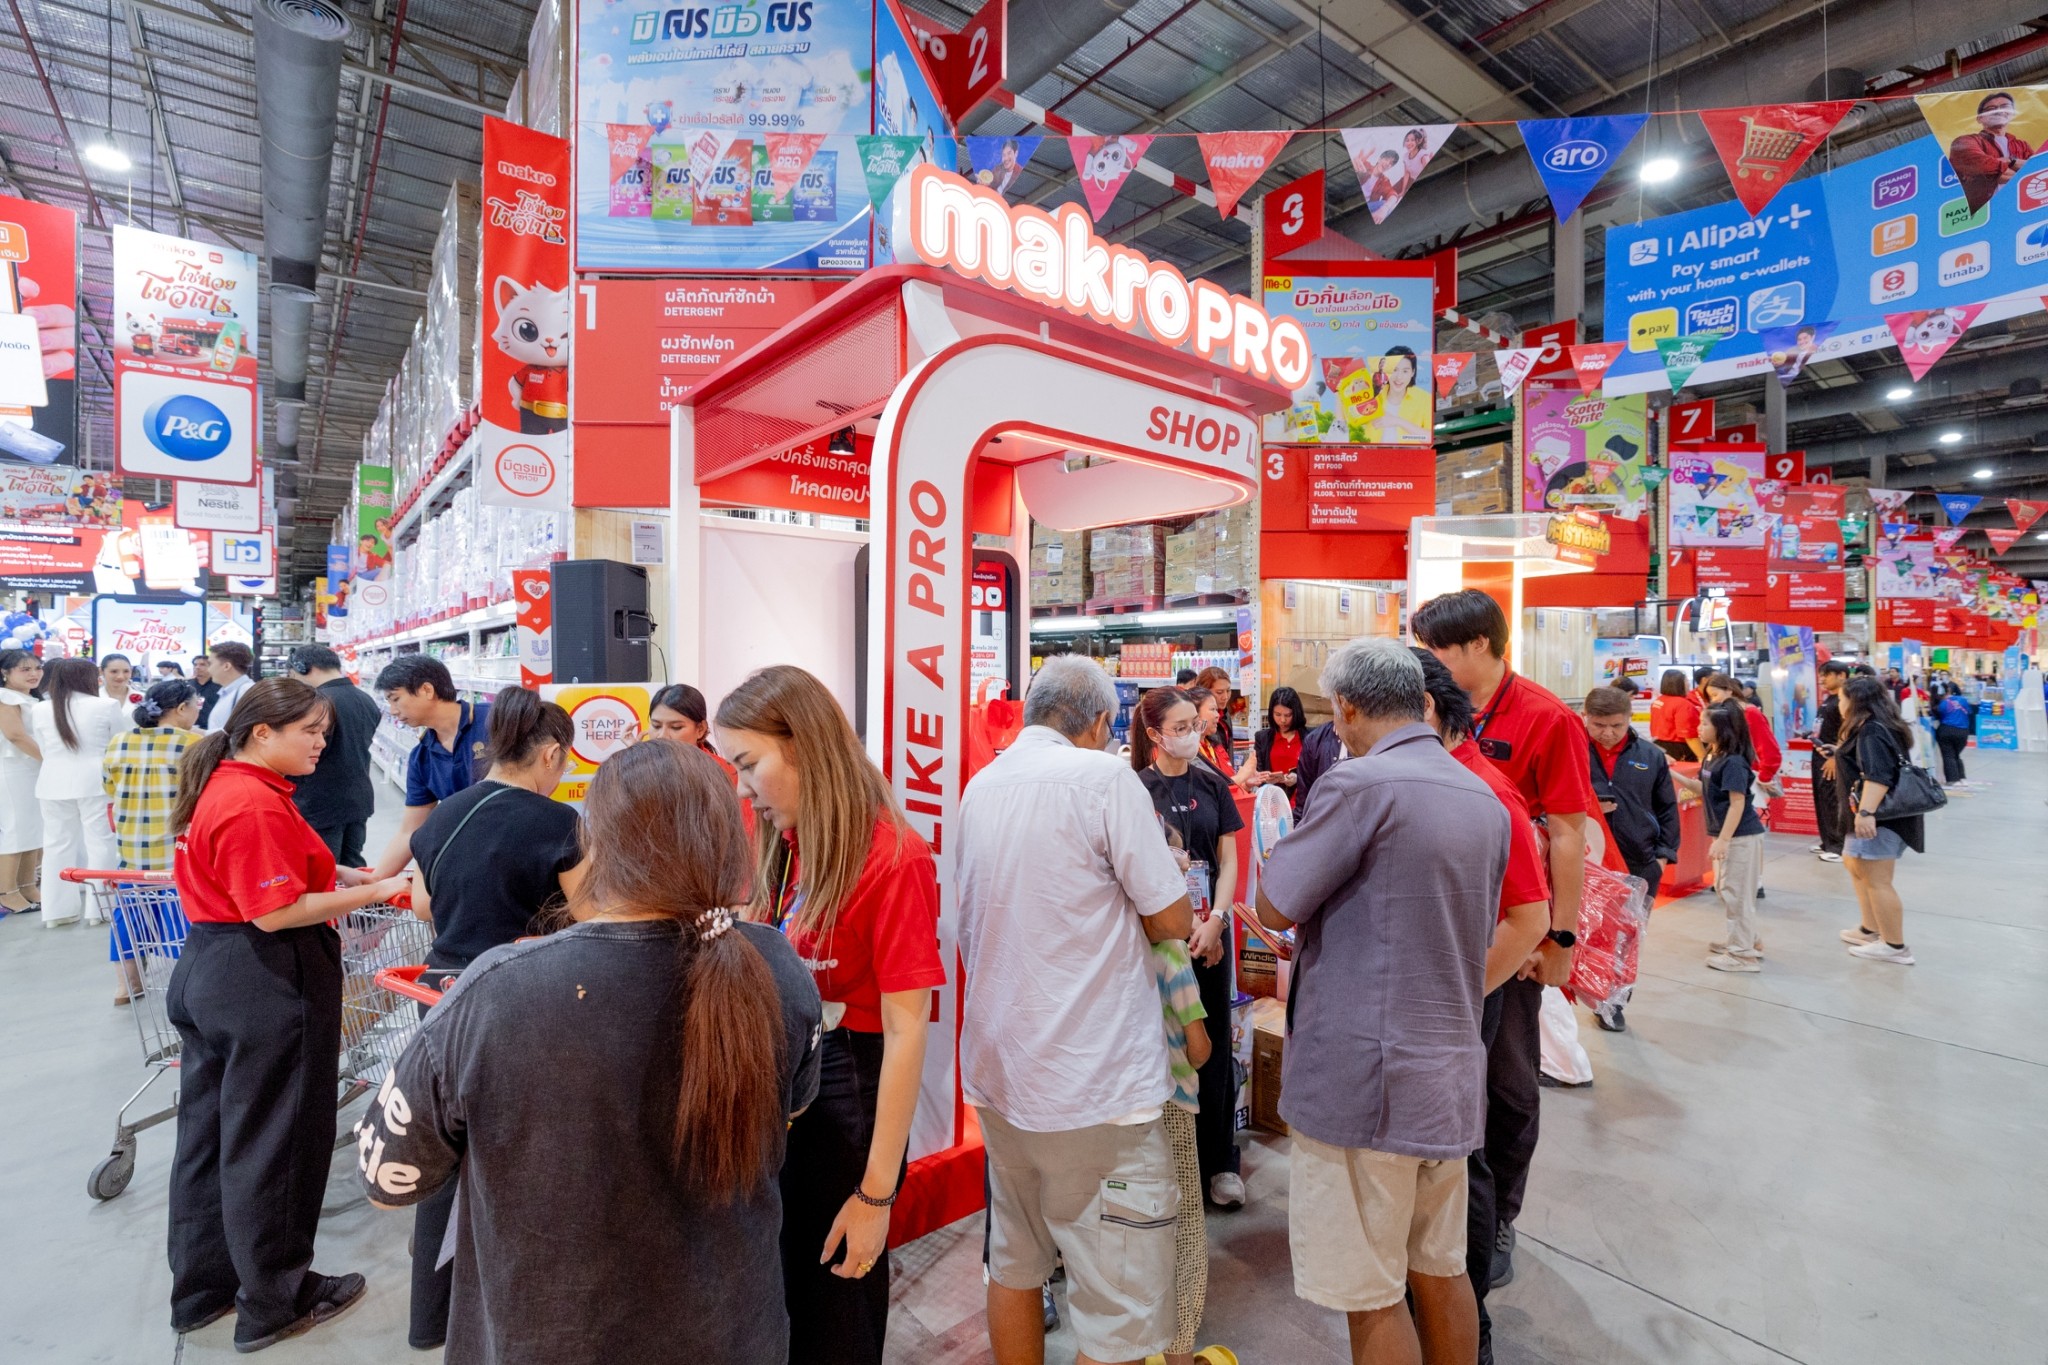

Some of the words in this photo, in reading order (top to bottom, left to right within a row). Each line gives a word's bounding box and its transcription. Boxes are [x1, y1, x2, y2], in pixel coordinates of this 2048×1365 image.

[662, 8, 709, 40] โปร
[765, 1, 813, 33] โปร
[968, 26, 988, 90] 2
[749, 113, 805, 127] 99.99%
[1210, 152, 1264, 170] makro
[1550, 147, 1598, 167] aro
[498, 160, 556, 187] makro
[1879, 171, 1912, 187] CHANGI
[1879, 182, 1911, 200] Pay
[1281, 194, 1304, 235] 3
[1671, 260, 1704, 279] Pay
[1710, 248, 1759, 271] smart
[1944, 264, 1984, 281] tinaba
[920, 174, 1193, 340] makro
[1198, 286, 1309, 386] PRO
[1265, 278, 1291, 290] Me-O
[1627, 286, 1656, 303] with
[1661, 282, 1691, 300] your
[1696, 272, 1737, 289] home
[1740, 254, 1810, 280] e-wallets
[665, 286, 775, 304] ผลิตภัณฑ์ซักผ้า
[579, 285, 596, 330] 1
[664, 307, 724, 317] DETERGENT
[1690, 304, 1734, 320] Touch
[1649, 324, 1669, 336] pay
[661, 334, 735, 351] ผงซักฟอก
[1539, 334, 1561, 364] 5
[661, 354, 721, 364] DETERGENT
[1580, 360, 1605, 371] PRO
[1736, 356, 1770, 369] makr
[1570, 412, 1602, 426] Brite
[1681, 408, 1701, 434] 7
[162, 416, 223, 441] P&G
[1146, 406, 1240, 456] SHOP
[1267, 453, 1285, 480] 3
[1776, 458, 1794, 478] 9
[907, 479, 947, 617] PRO
[1670, 551, 1682, 566] 7
[1767, 575, 1777, 587] 9
[907, 643, 944, 691] A
[1626, 662, 1647, 671] DAYS
[581, 719, 625, 729] STAMP
[585, 730, 622, 740] HERE
